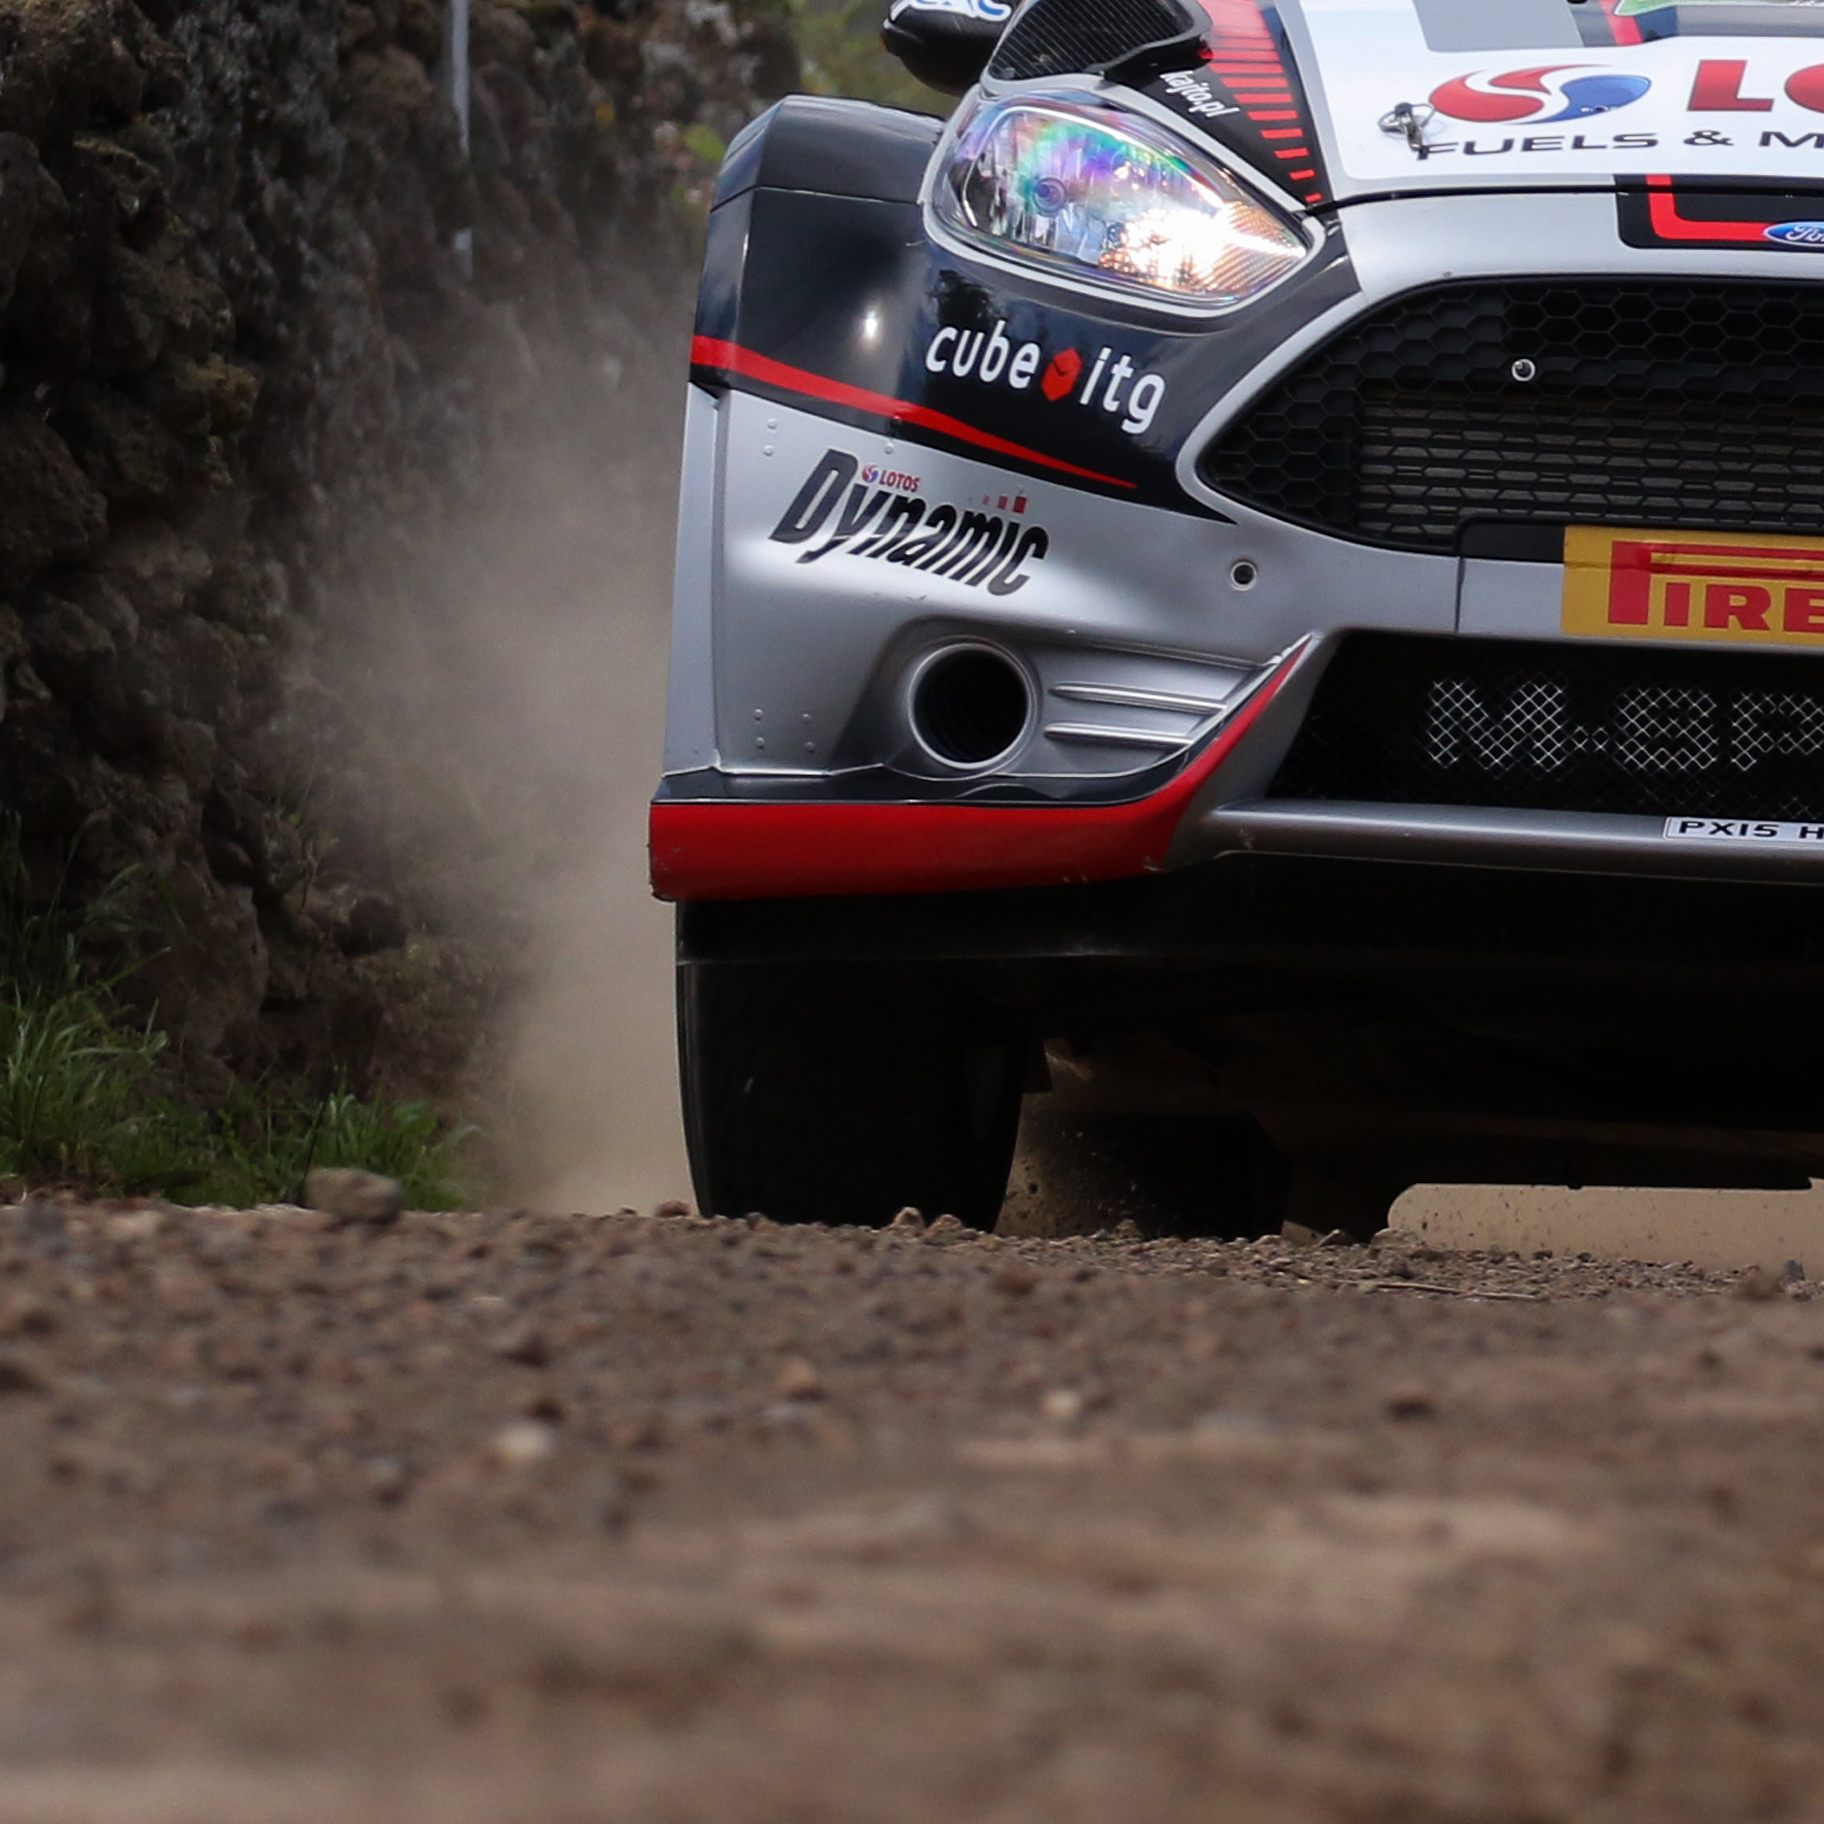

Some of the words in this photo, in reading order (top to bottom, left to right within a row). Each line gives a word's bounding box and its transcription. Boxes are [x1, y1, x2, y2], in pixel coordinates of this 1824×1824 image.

[1160, 70, 1240, 120] kajto.pl
[1416, 131, 1659, 162] FUELS
[1683, 131, 1733, 147] &
[924, 321, 1040, 389] cube
[1080, 347, 1167, 436] itg
[879, 467, 921, 492] LOTOS
[769, 448, 1051, 596] Dynamic
[1678, 821, 1779, 836] PX15
